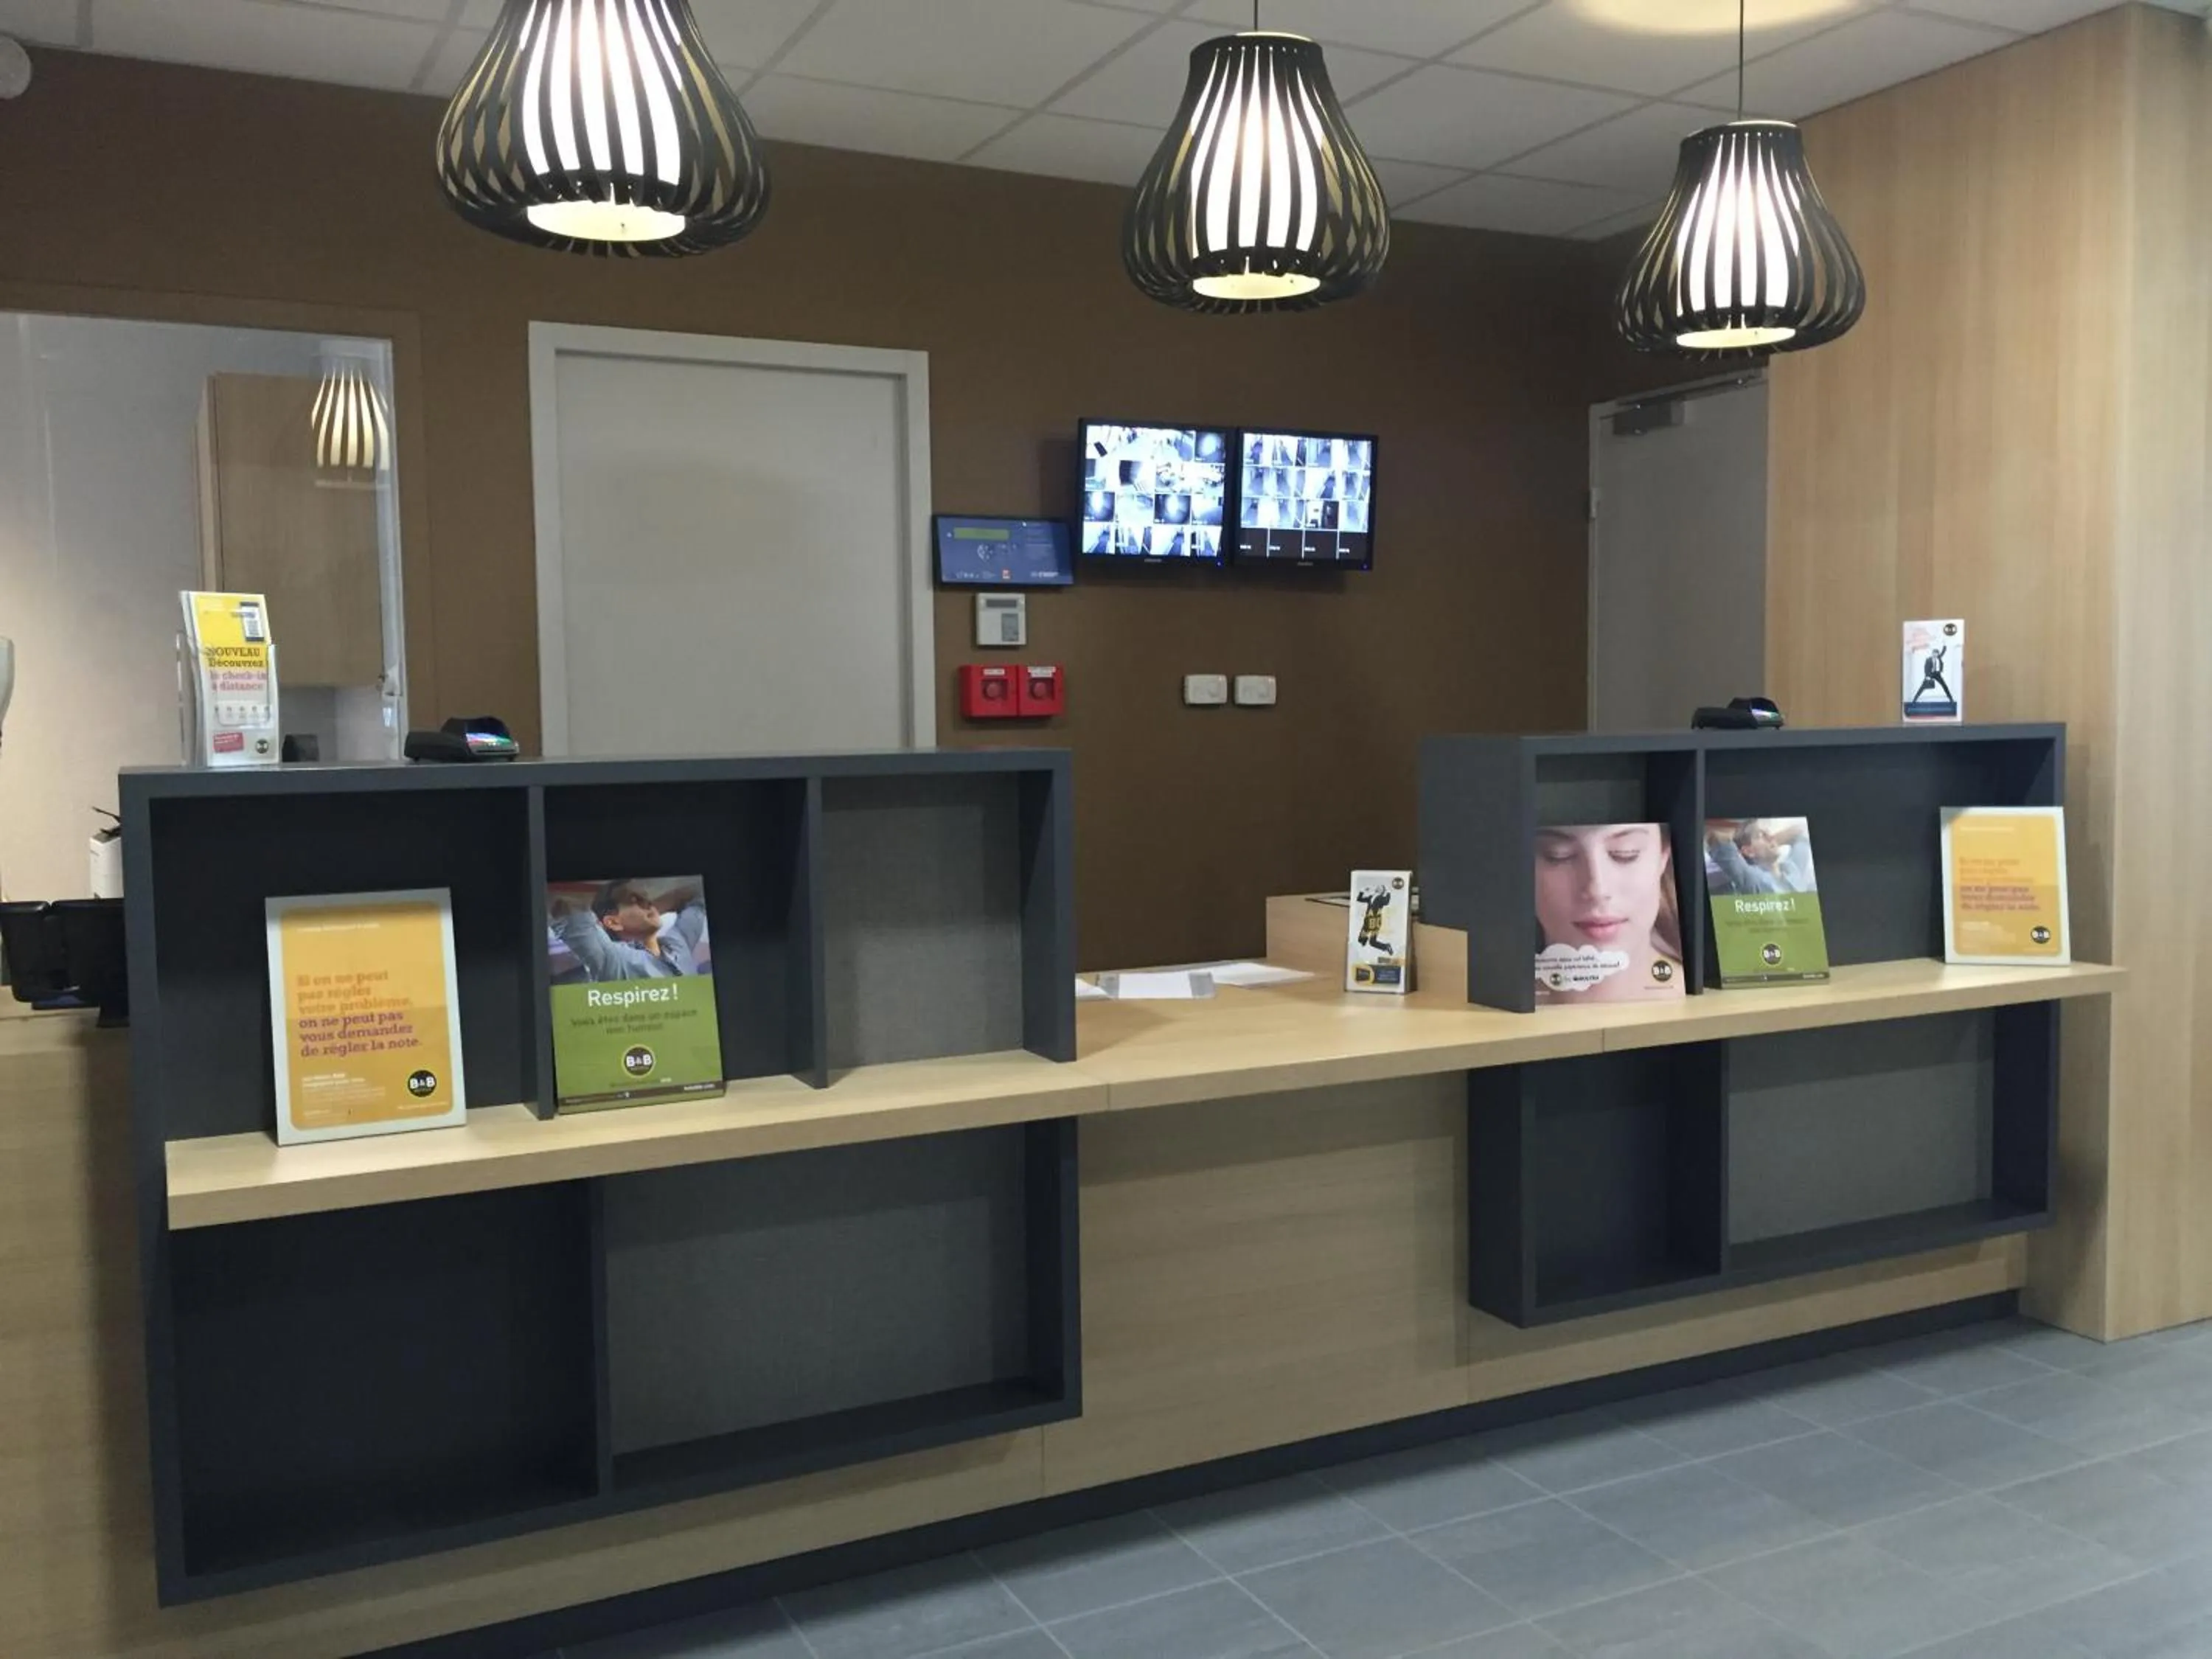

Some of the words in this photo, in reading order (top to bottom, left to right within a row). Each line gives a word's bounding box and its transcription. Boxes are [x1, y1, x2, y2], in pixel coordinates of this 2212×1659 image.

[299, 1018, 318, 1029] on
[321, 1017, 339, 1027] ne
[341, 1012, 375, 1029] peut
[377, 1011, 403, 1026] pas
[299, 1032, 335, 1043] vous
[336, 1023, 413, 1040] demandez
[301, 1045, 319, 1057] de
[372, 1040, 385, 1051] la
[626, 1053, 653, 1068] B&B
[408, 1075, 436, 1090] B&B
